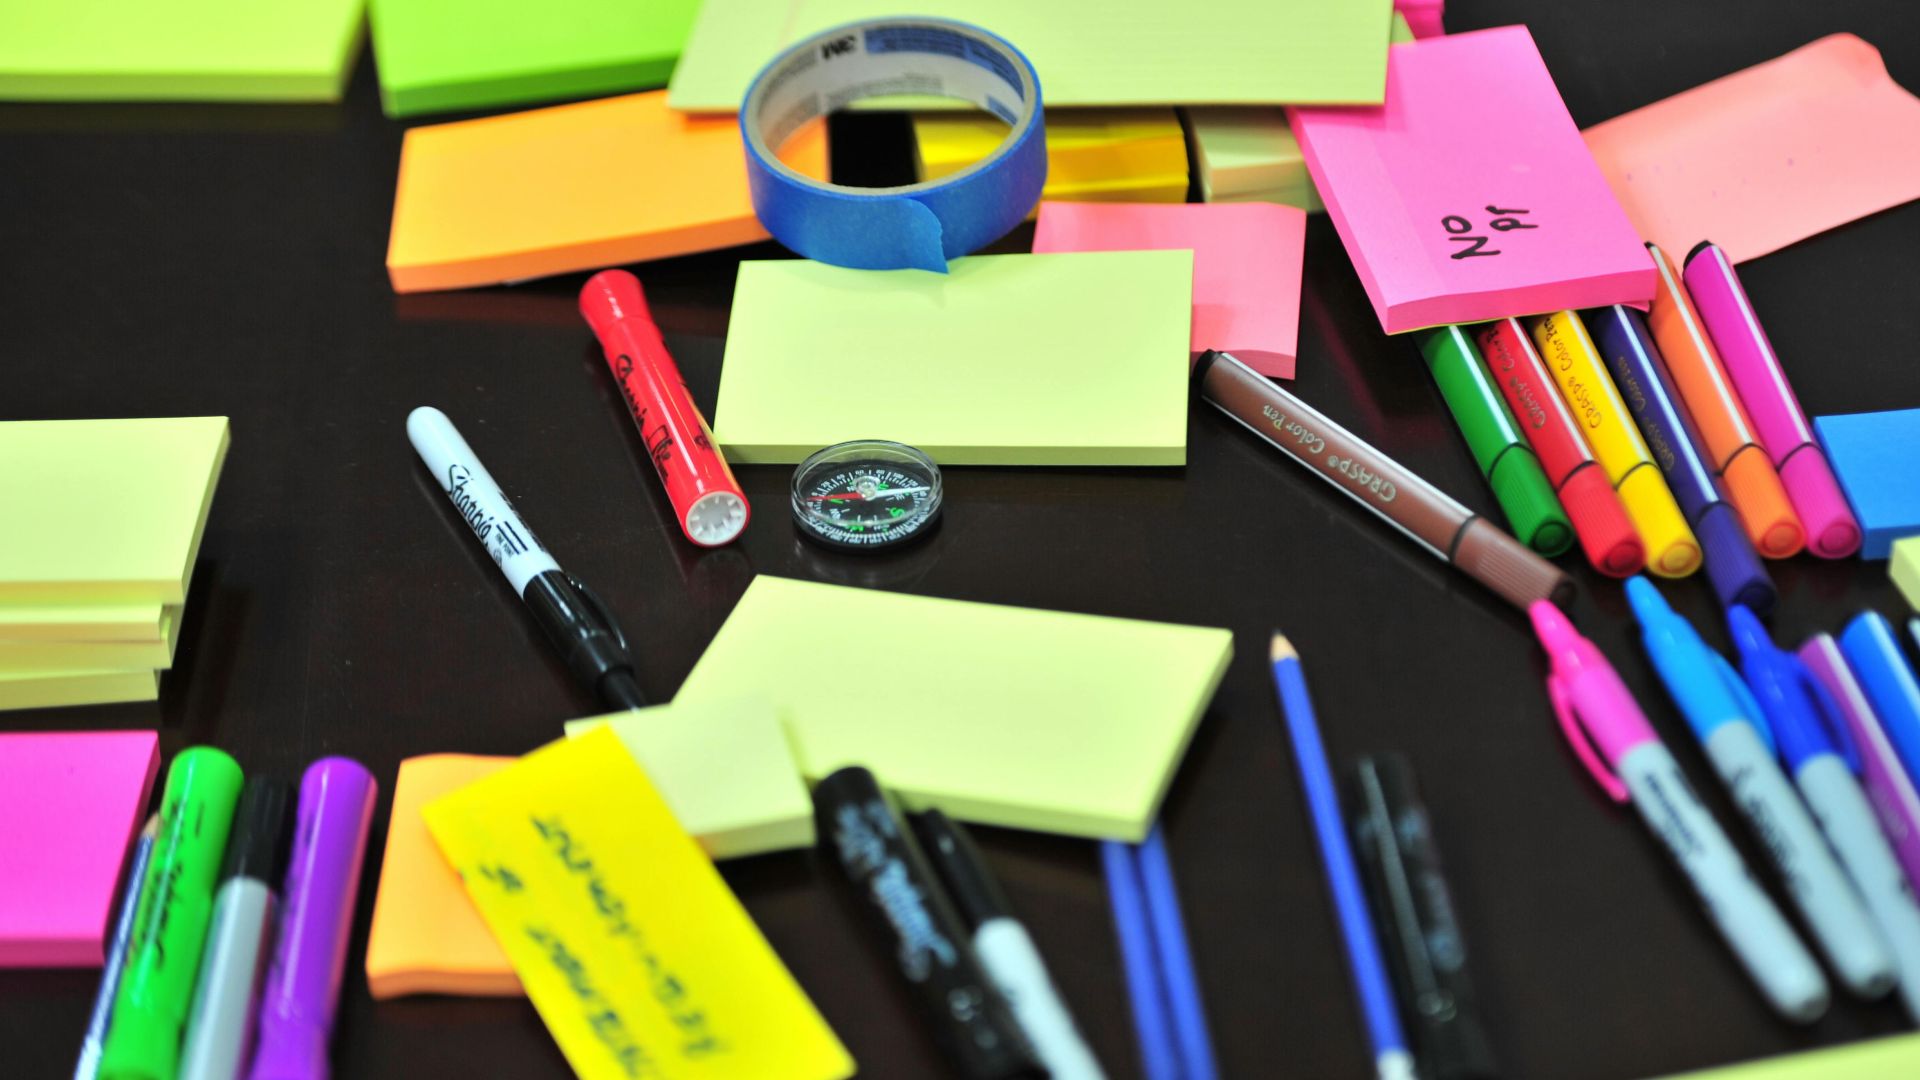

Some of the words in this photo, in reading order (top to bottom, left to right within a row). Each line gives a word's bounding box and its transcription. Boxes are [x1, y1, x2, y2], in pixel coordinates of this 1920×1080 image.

[1543, 317, 1558, 344] Pen
[1553, 339, 1573, 372] Color
[1262, 404, 1288, 431] Pen
[1285, 424, 1326, 455] Color
[448, 464, 495, 541] Sharpie
